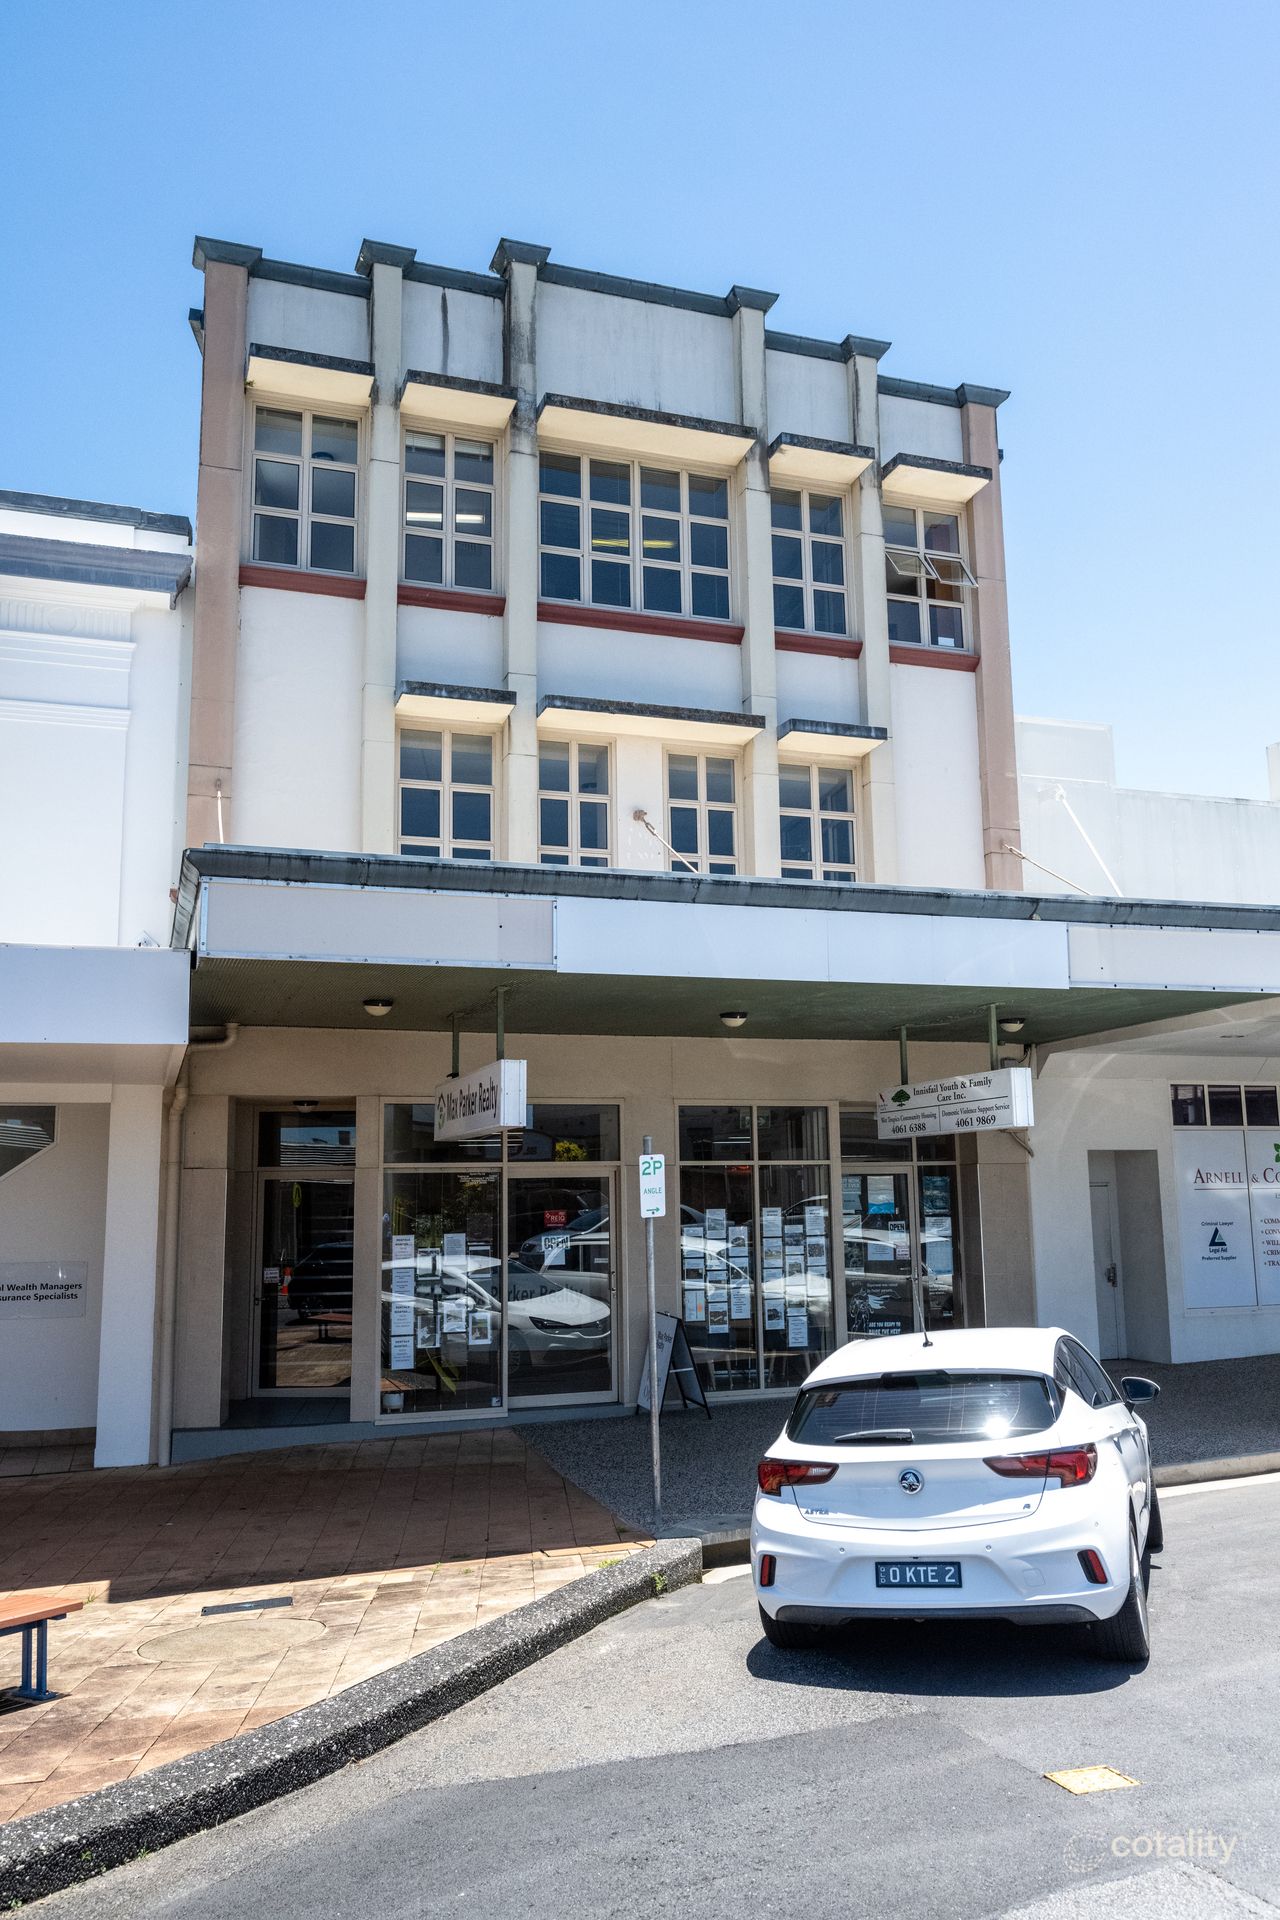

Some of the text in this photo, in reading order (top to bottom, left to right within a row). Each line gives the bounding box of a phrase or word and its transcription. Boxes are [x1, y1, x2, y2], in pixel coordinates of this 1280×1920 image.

[913, 1077, 993, 1096] Innisfail Youth & Family
[447, 1076, 498, 1121] Max Parker Realty
[937, 1092, 967, 1102] Care Inc.
[995, 1102, 1010, 1110] Service
[955, 1114, 996, 1128] 4061 9869
[892, 1122, 927, 1134] 4061 6388
[641, 1160, 663, 1176] 2P
[643, 1187, 662, 1195] ANGLE
[889, 1223, 905, 1232] OPEN
[7, 1283, 37, 1291] Wealth
[40, 1283, 82, 1291] Managers
[34, 1292, 78, 1302] Specialists
